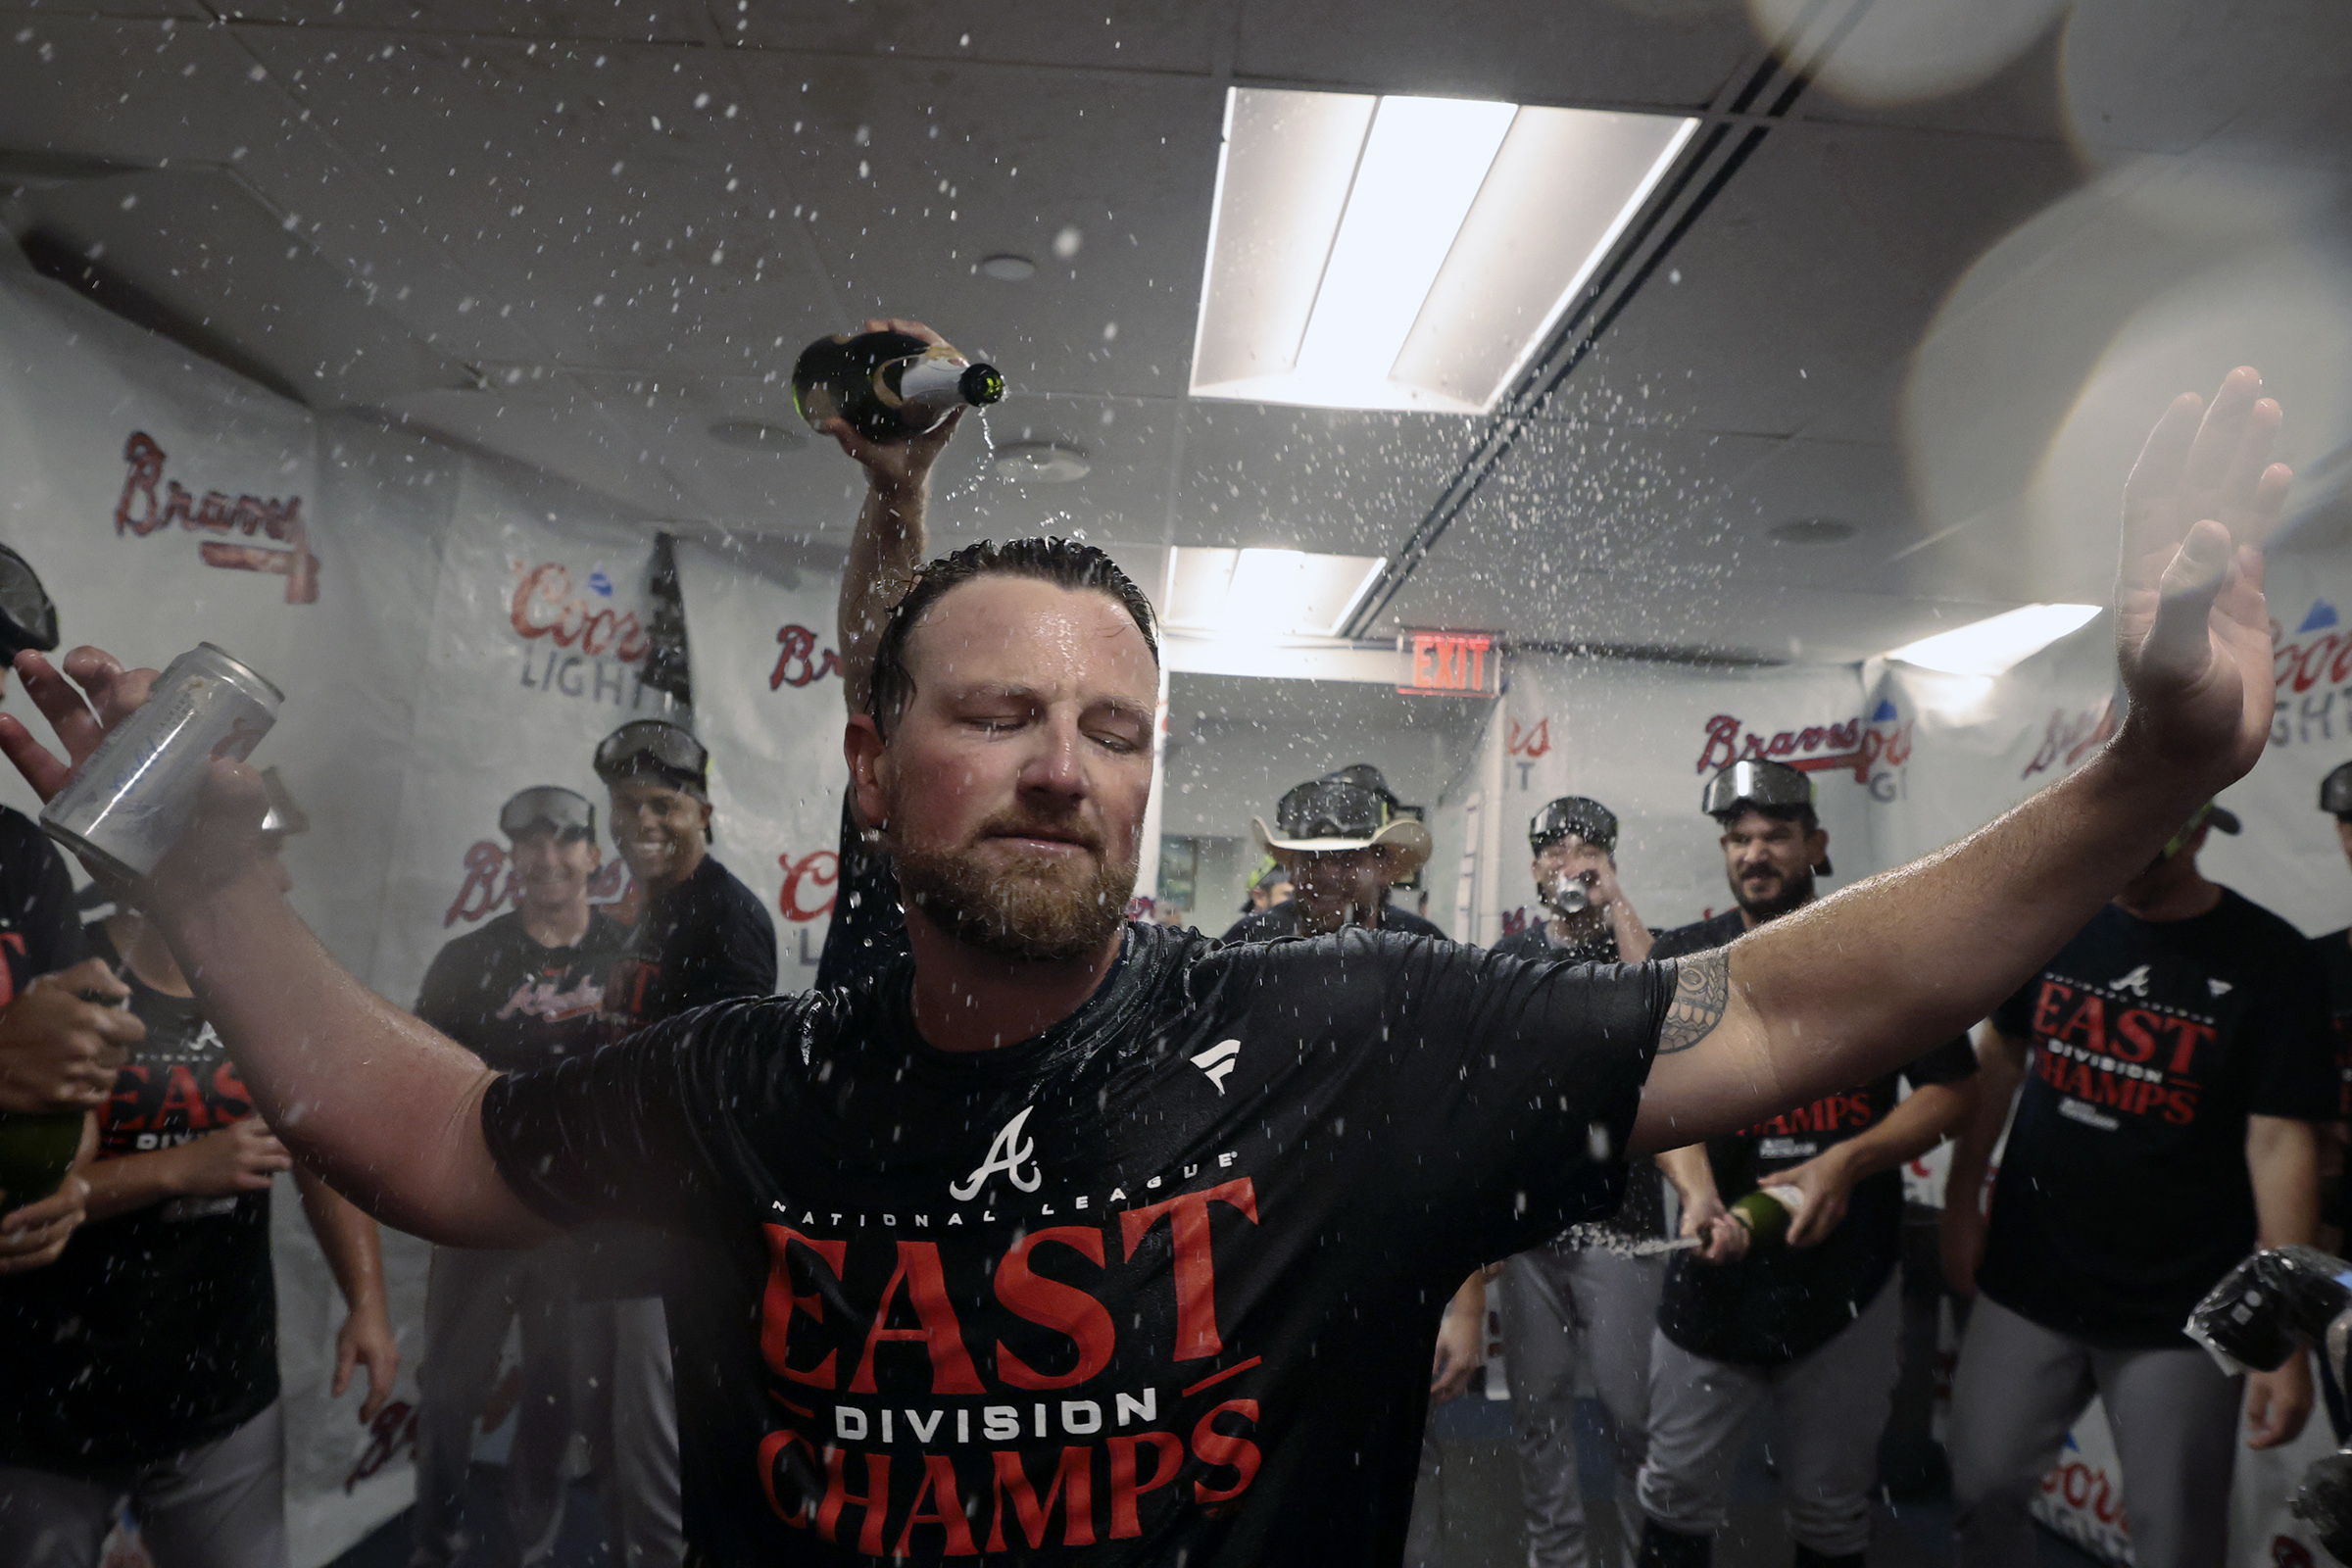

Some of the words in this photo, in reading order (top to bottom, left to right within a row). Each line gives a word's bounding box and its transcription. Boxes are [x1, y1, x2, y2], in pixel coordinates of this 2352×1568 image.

[1413, 635, 1492, 691] EXIT
[2033, 980, 2218, 1075] EAST
[99, 1060, 252, 1131] EAS
[2036, 1044, 2199, 1125] HAMPS
[770, 1199, 997, 1227] NATIONAL
[1041, 1152, 1235, 1216] LEAGUE
[760, 1176, 1260, 1396] EAST
[834, 1387, 1158, 1445] DIVISION
[757, 1397, 1263, 1558] CHAMPS
